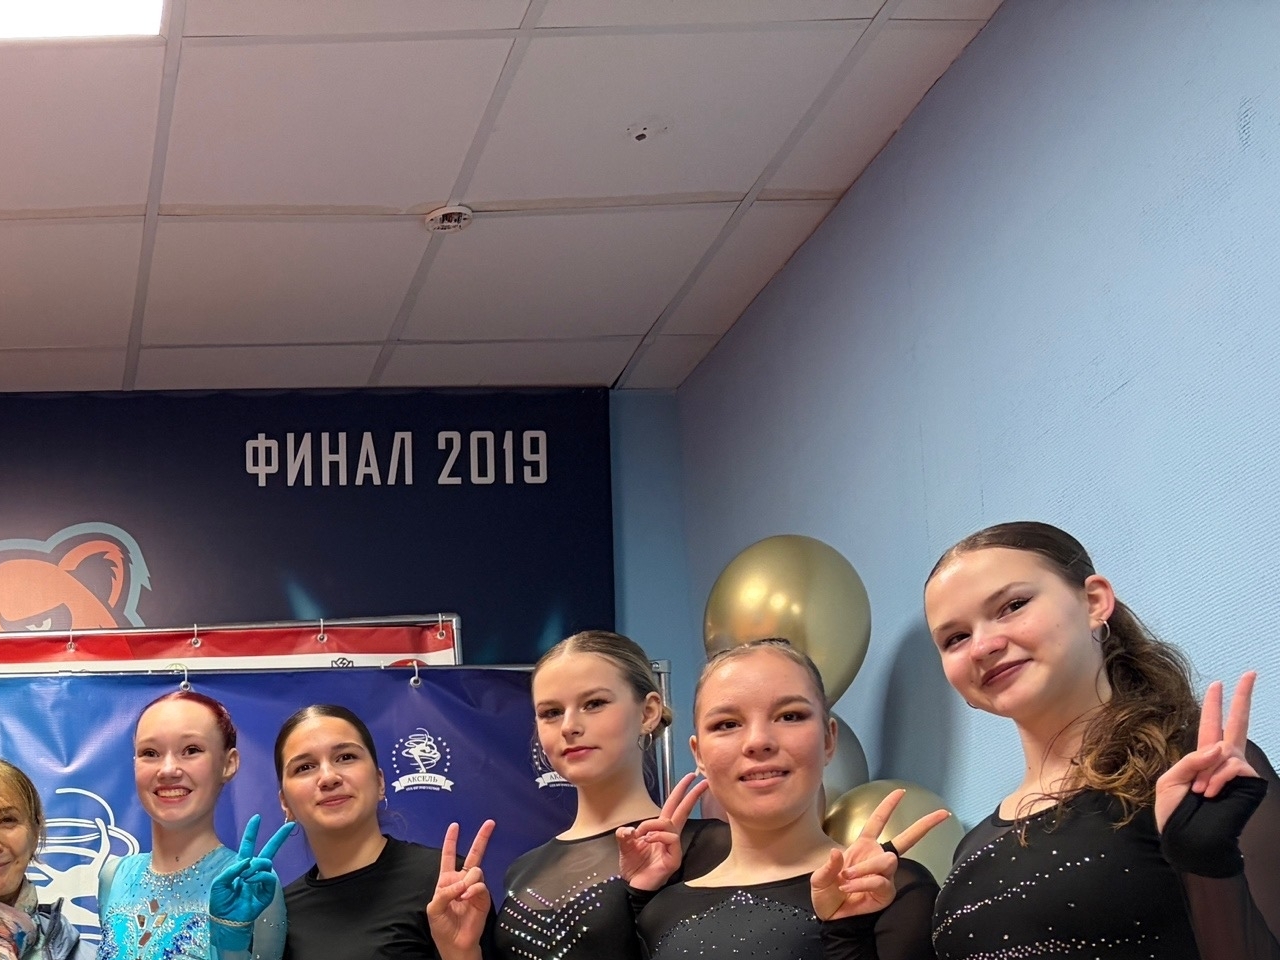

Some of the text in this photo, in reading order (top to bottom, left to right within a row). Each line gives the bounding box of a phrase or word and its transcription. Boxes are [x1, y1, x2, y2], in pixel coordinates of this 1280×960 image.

[245, 430, 548, 487] ФИНАЛ 2019
[407, 775, 438, 783] АКСЕЛЬ
